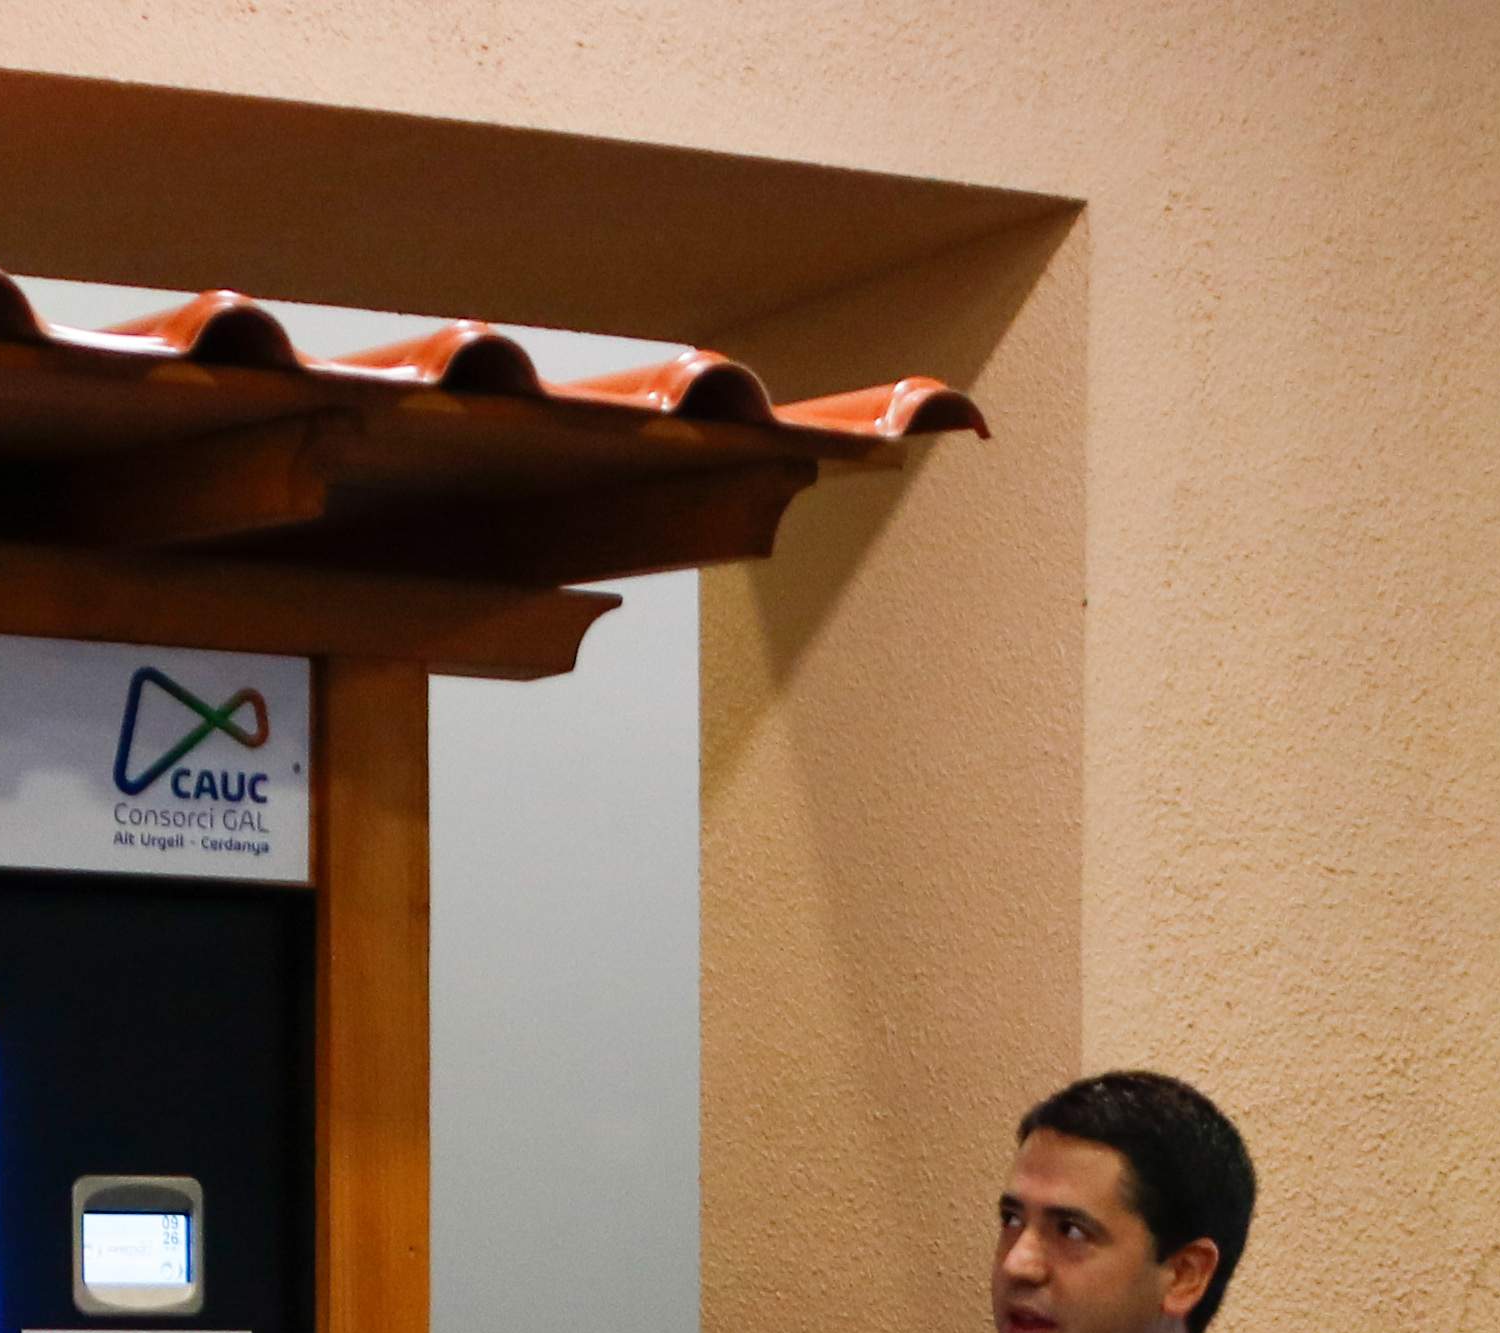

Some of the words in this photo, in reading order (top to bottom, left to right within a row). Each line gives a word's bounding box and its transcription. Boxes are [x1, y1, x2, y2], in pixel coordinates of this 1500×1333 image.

[171, 767, 270, 804] CAUC
[113, 802, 214, 829] Consorci
[222, 809, 270, 833] GAL
[113, 831, 135, 846] Alt
[140, 832, 184, 850] Urgell
[201, 835, 269, 856] Cerdanya
